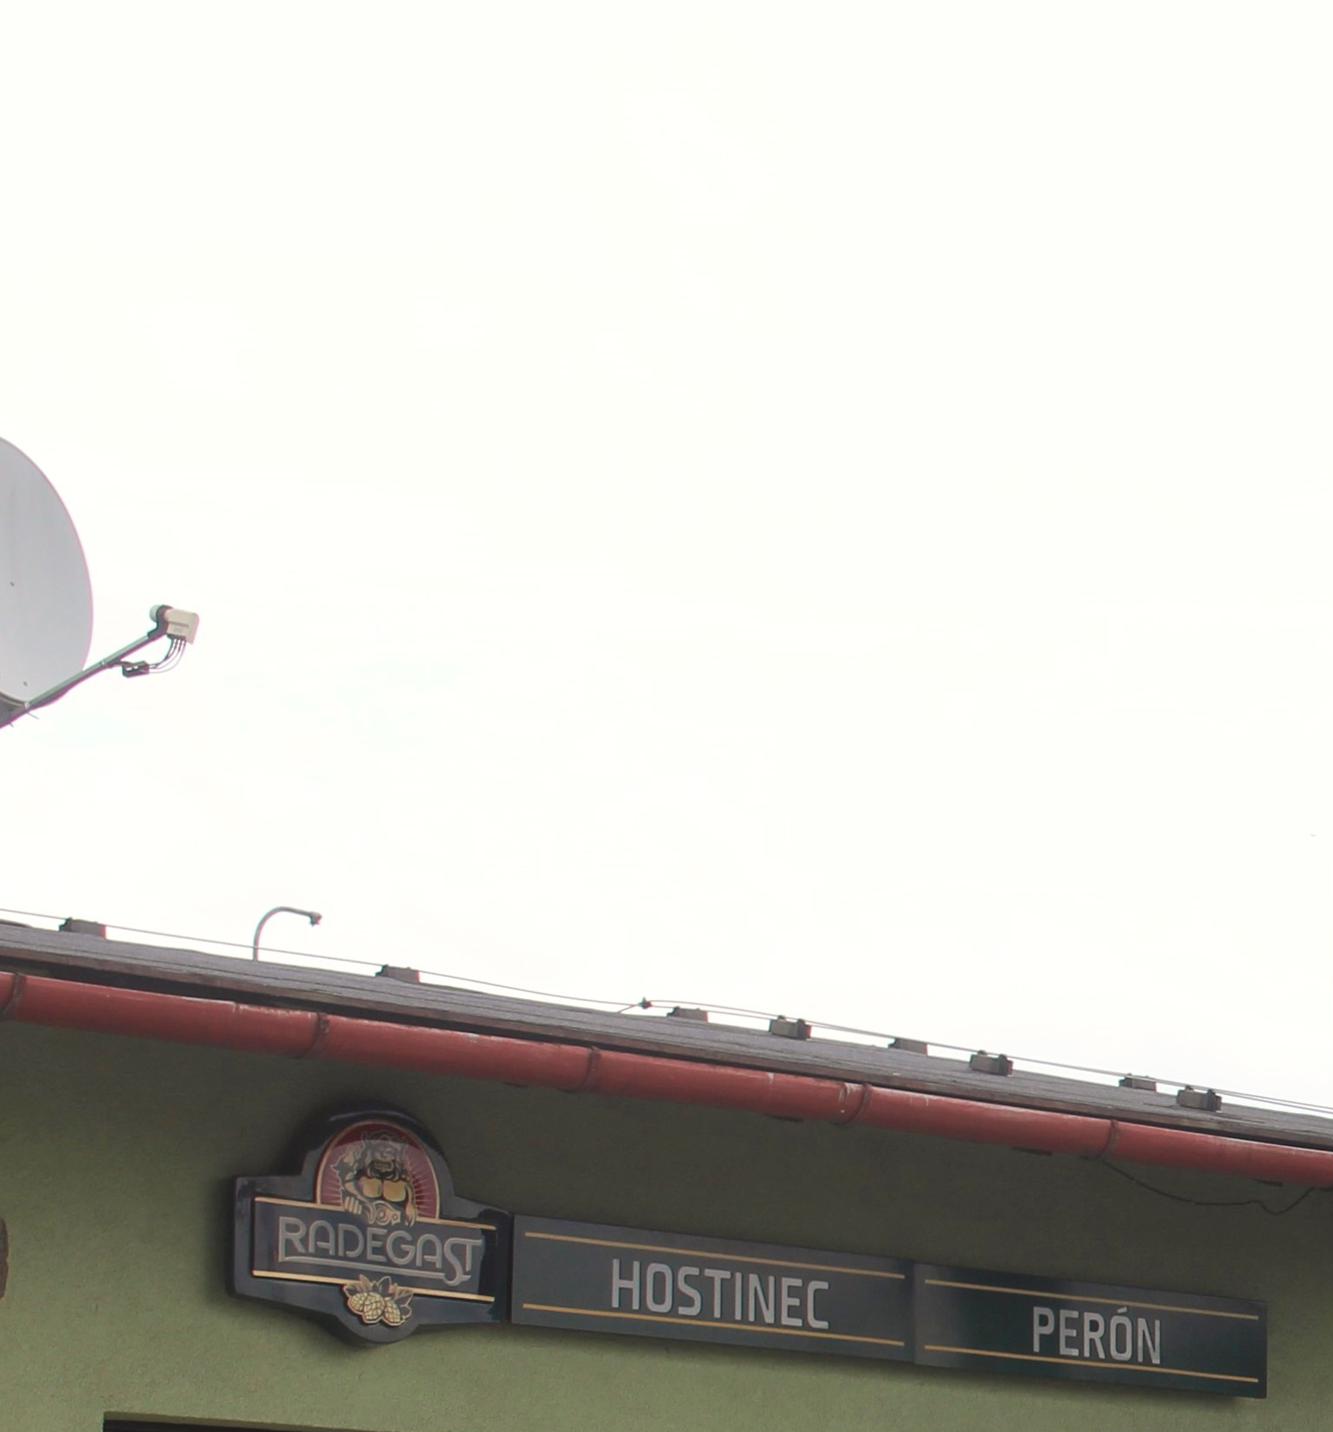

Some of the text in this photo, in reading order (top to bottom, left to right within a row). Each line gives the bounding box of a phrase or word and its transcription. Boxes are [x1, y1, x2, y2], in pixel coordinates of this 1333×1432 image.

[277, 1215, 483, 1287] RADEGAST
[611, 1258, 830, 1330] HOSTINEC
[1032, 1307, 1162, 1365] PERÓN
